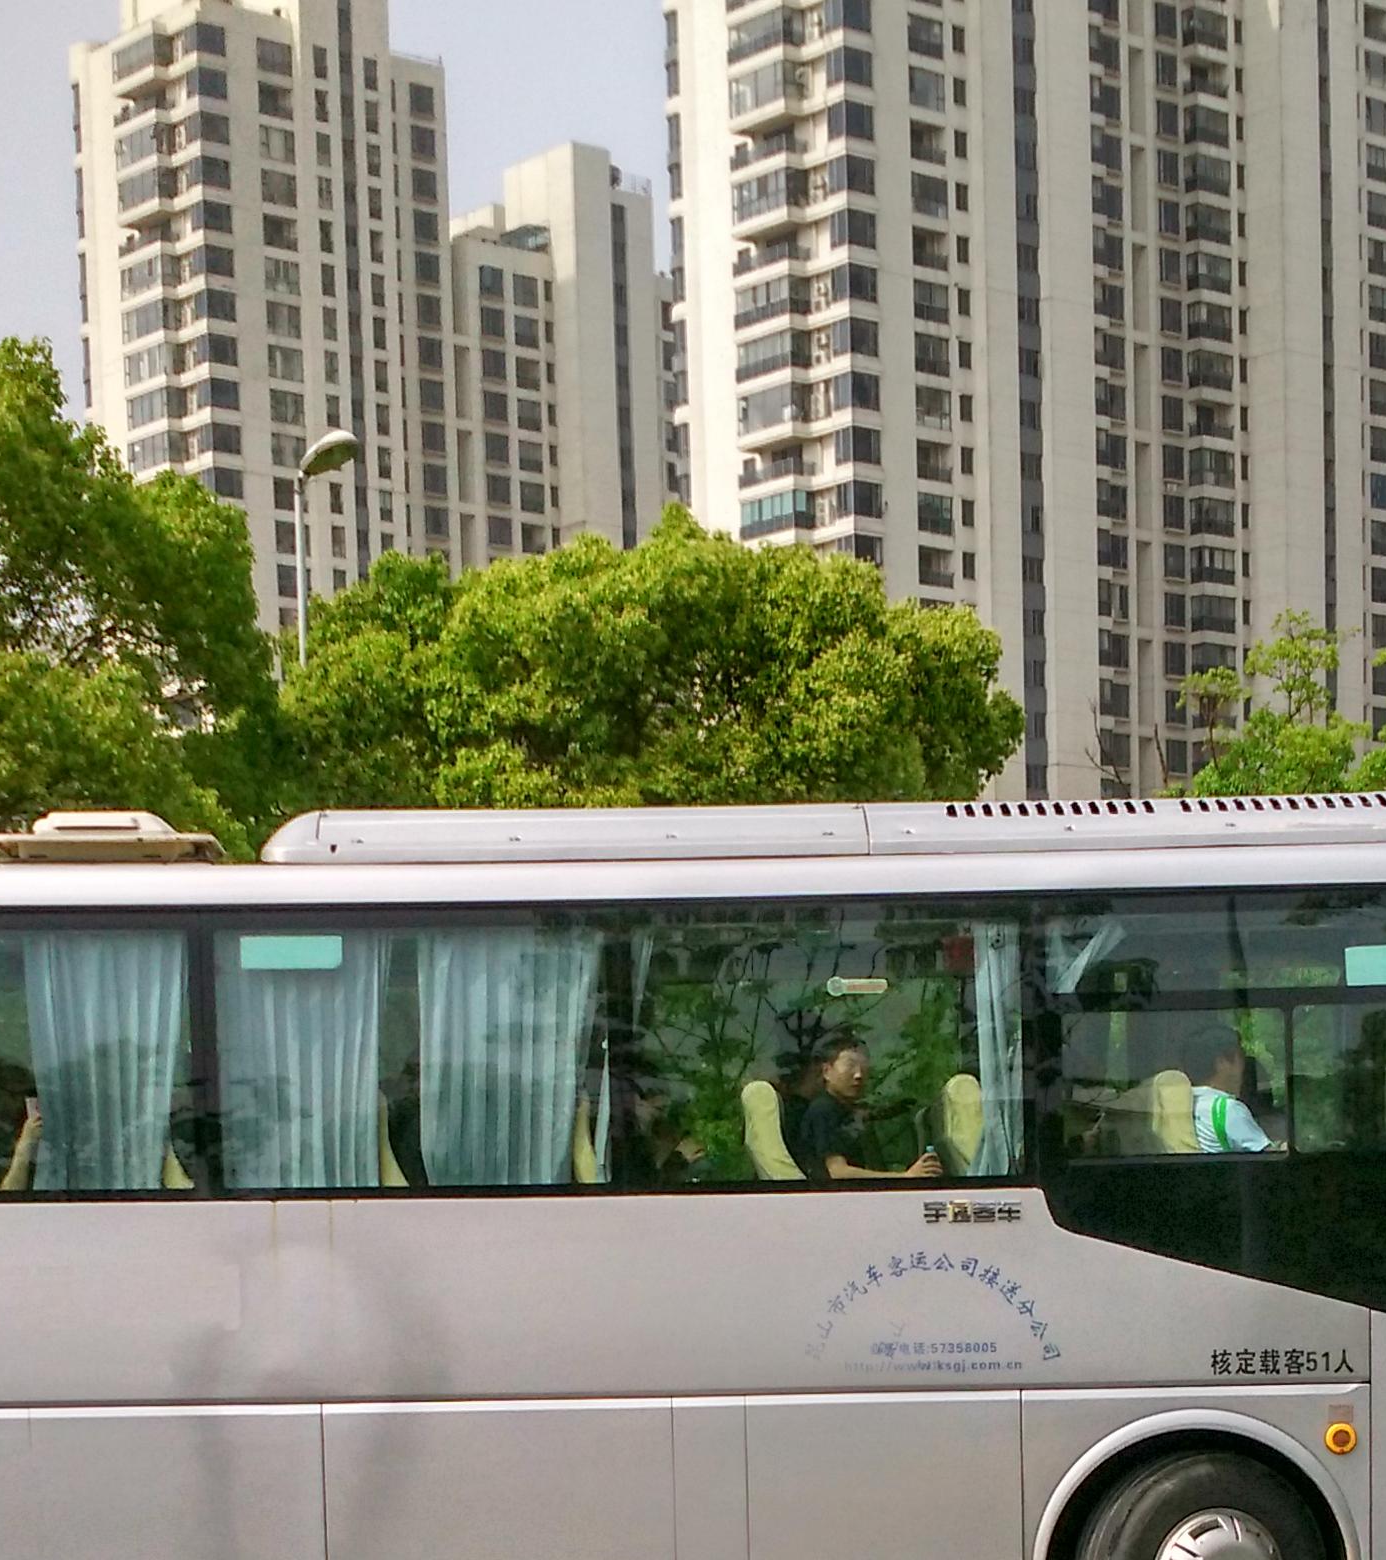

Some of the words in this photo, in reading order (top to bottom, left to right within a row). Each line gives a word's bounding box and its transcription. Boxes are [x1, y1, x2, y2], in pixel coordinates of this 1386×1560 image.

[922, 1200, 1022, 1224] 宇通客车
[1210, 1348, 1354, 1375] 核定载客51人
